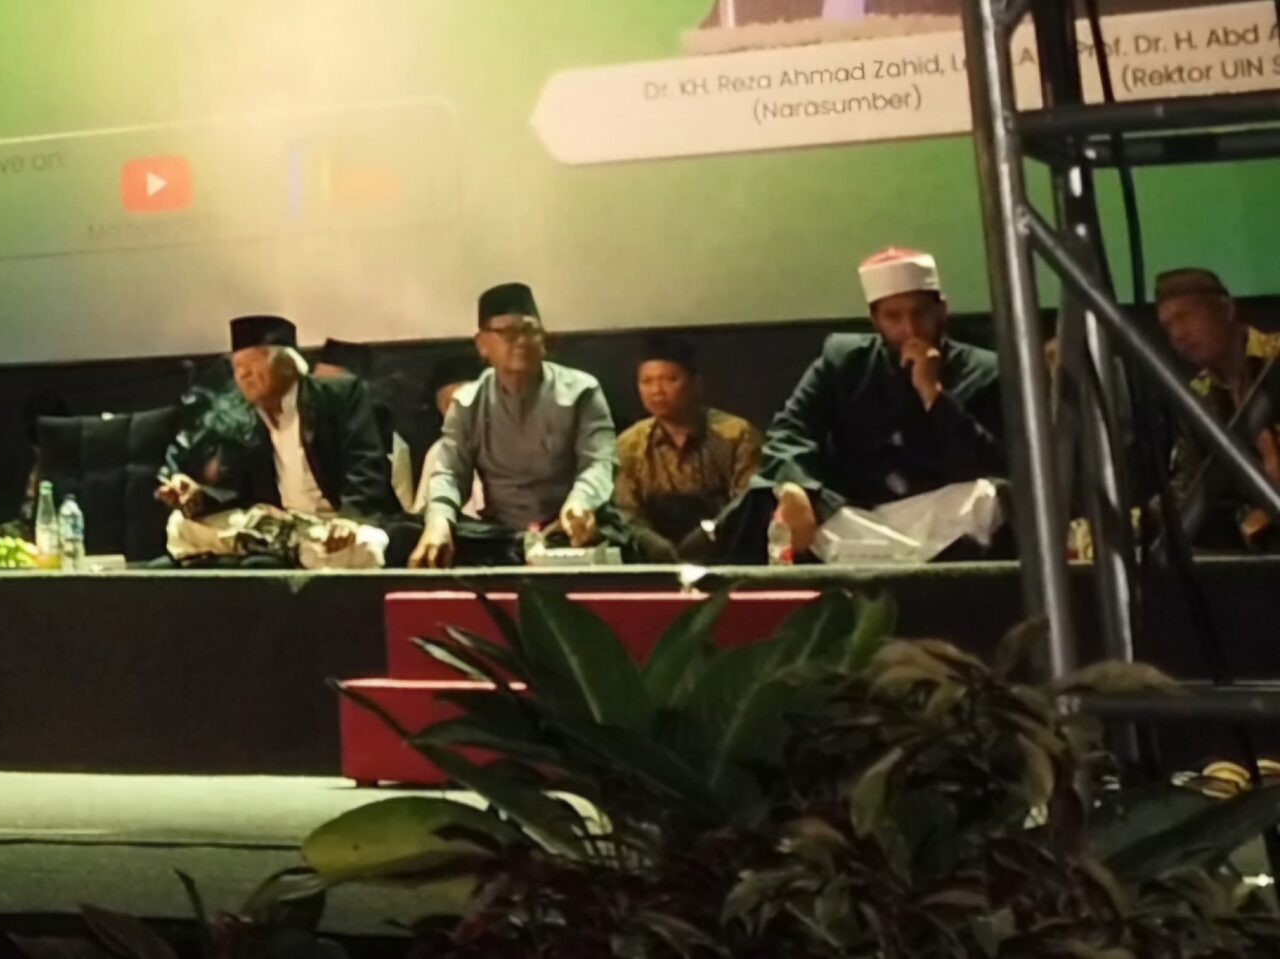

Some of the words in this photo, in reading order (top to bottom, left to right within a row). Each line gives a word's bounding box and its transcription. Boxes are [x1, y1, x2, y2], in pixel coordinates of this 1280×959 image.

[1135, 35, 1167, 55] Dr.
[1175, 30, 1197, 51] H.
[1207, 24, 1259, 47] Abd
[718, 74, 771, 93] Reza
[780, 62, 865, 87] Ahmad
[873, 54, 945, 78] Zahid,
[1122, 62, 1213, 92] (Rektor
[1221, 57, 1263, 80] UIN
[753, 84, 921, 125] (Narasumber)
